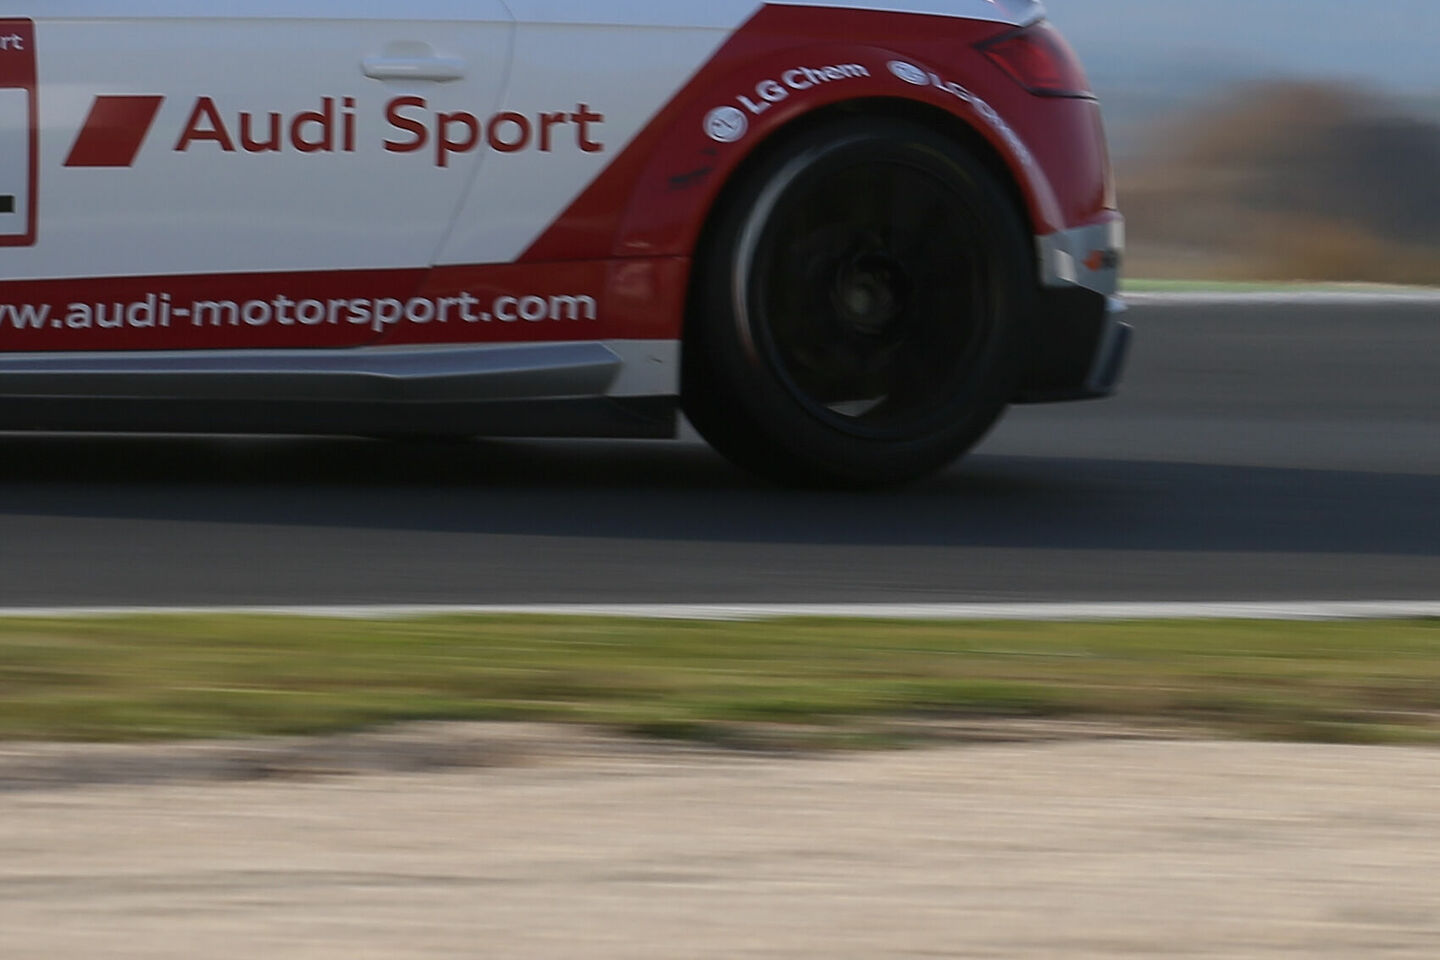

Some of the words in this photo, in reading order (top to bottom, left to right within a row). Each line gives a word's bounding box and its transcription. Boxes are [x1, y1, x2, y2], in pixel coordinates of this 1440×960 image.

[736, 79, 789, 115] LG
[781, 63, 871, 90] Chem
[173, 96, 357, 152] Audi
[382, 95, 606, 168] Sport
